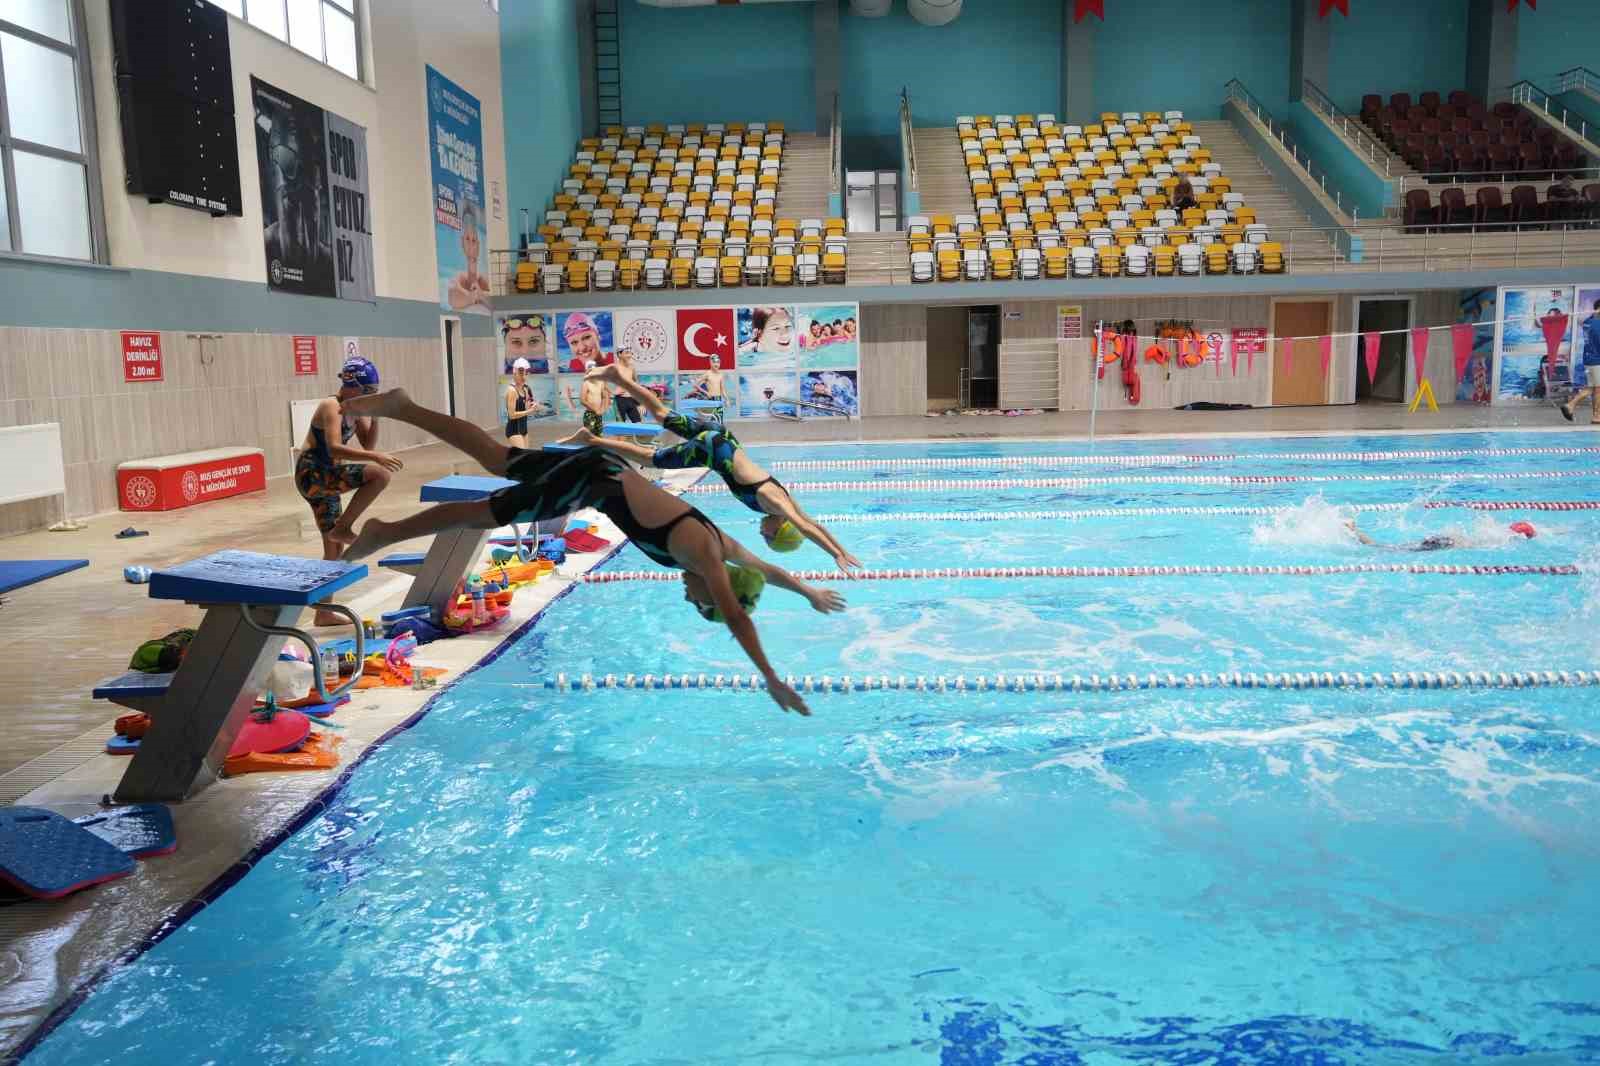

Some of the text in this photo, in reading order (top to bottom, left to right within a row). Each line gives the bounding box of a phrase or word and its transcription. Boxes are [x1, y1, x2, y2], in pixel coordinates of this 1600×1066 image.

[329, 131, 356, 181] SPOR
[169, 190, 227, 212] COLORADO TIME SYSTEMS
[129, 336, 152, 347] HAVUZ
